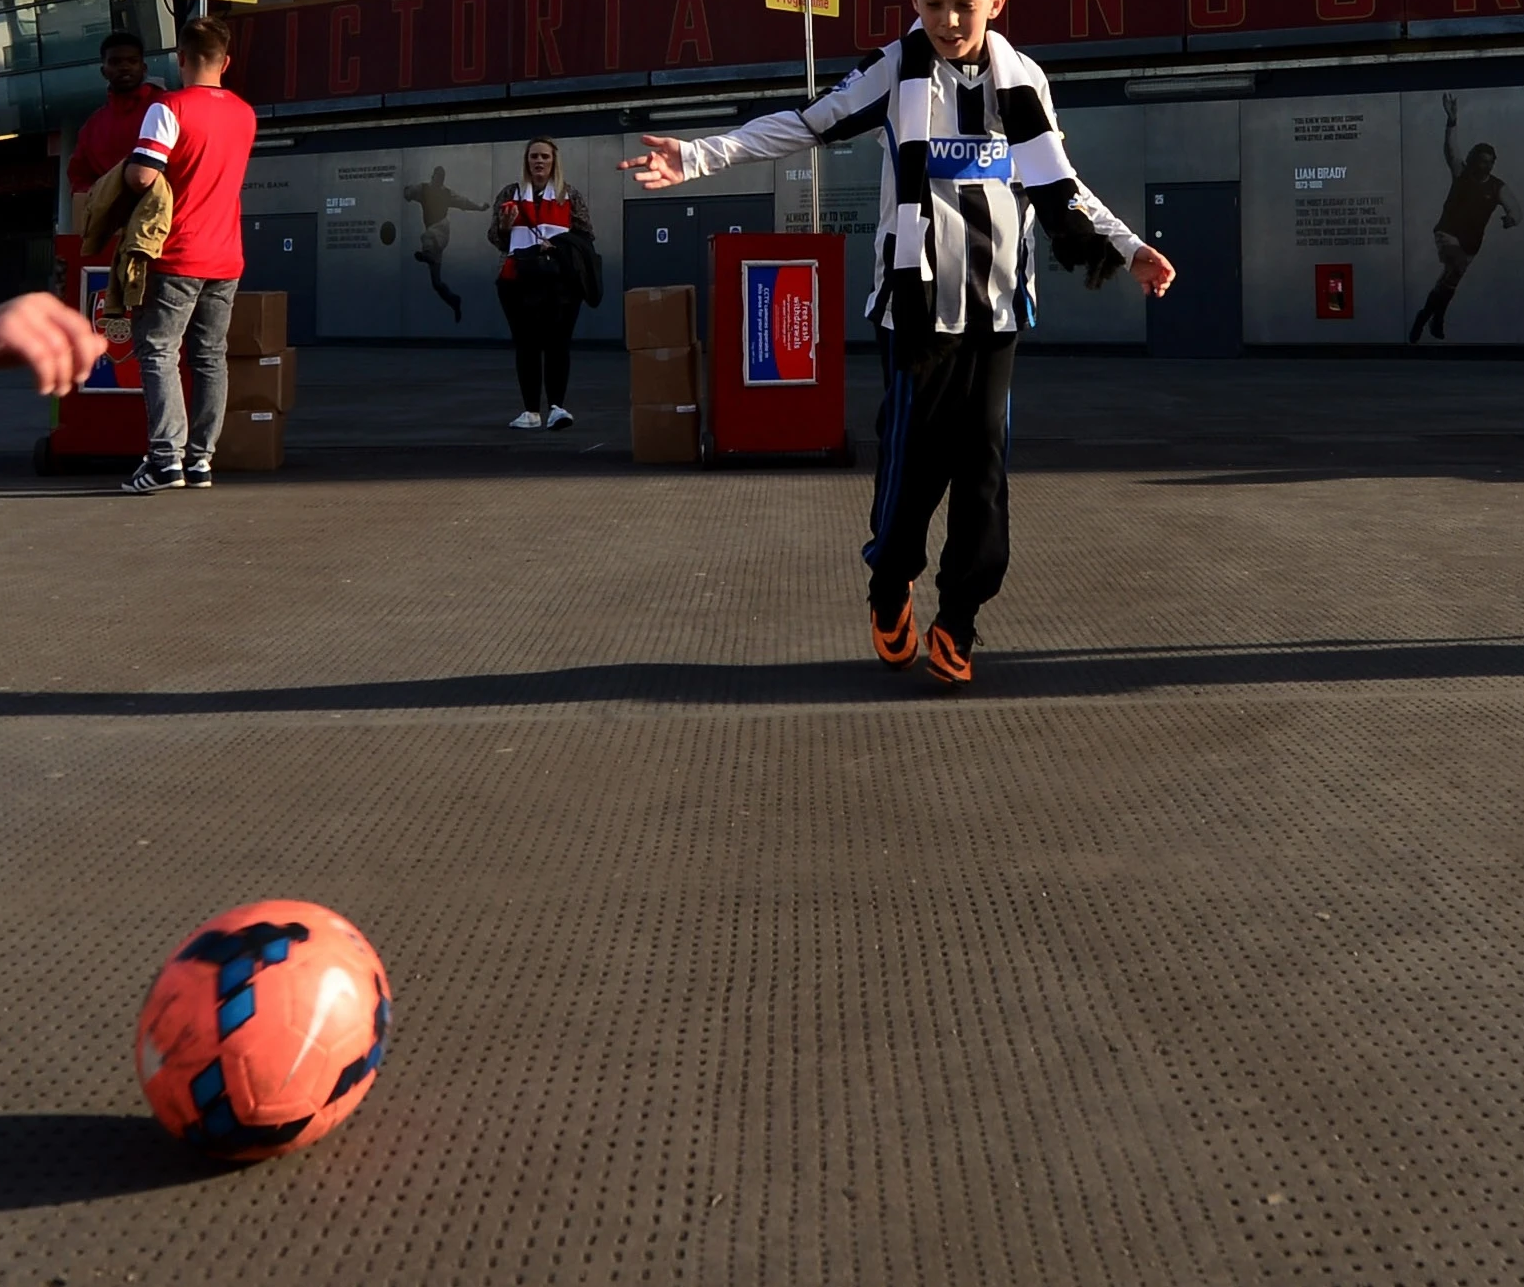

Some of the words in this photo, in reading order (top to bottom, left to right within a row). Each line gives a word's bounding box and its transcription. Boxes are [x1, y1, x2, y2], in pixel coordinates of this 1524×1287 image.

[1294, 167, 1315, 180] LIAM
[1317, 166, 1347, 180] BRADY
[802, 301, 810, 320] Free
[793, 296, 802, 350] withdrawals
[802, 321, 810, 341] cash
